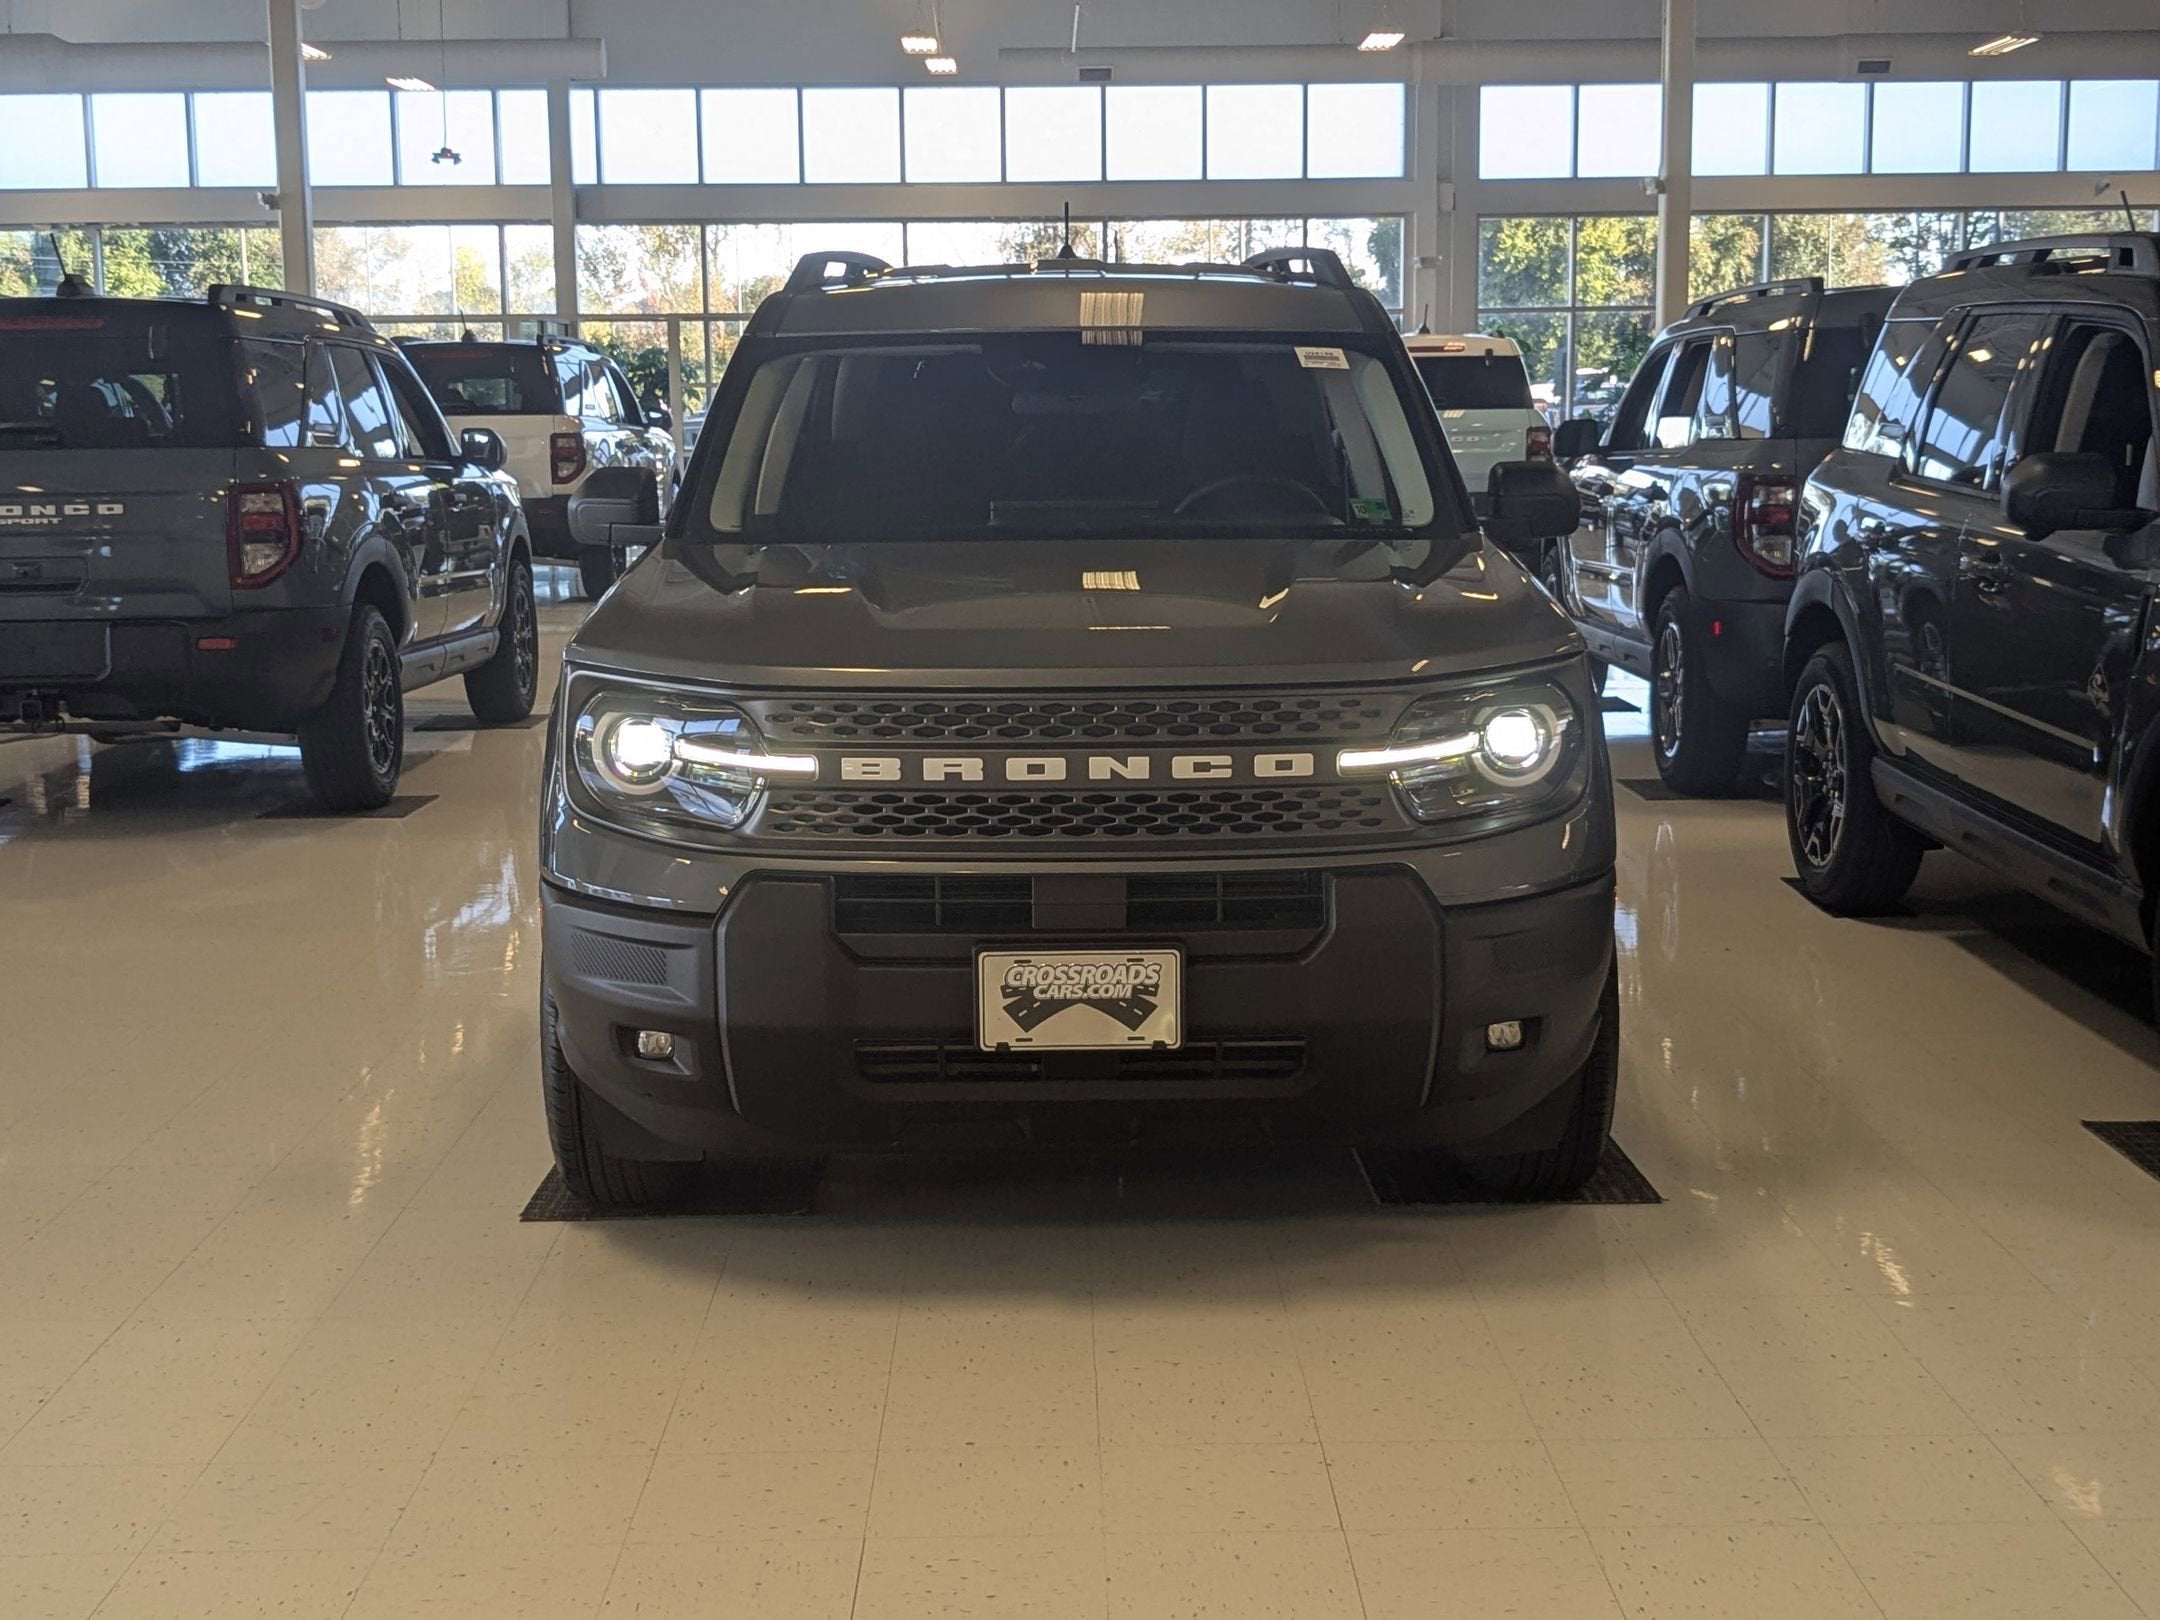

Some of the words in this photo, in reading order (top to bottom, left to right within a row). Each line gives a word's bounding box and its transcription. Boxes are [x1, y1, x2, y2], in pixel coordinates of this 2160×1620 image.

[841, 753, 1314, 781] BRONCO
[1005, 963, 1161, 987] CROSSROADS
[1032, 984, 1133, 999] CARS.COM
